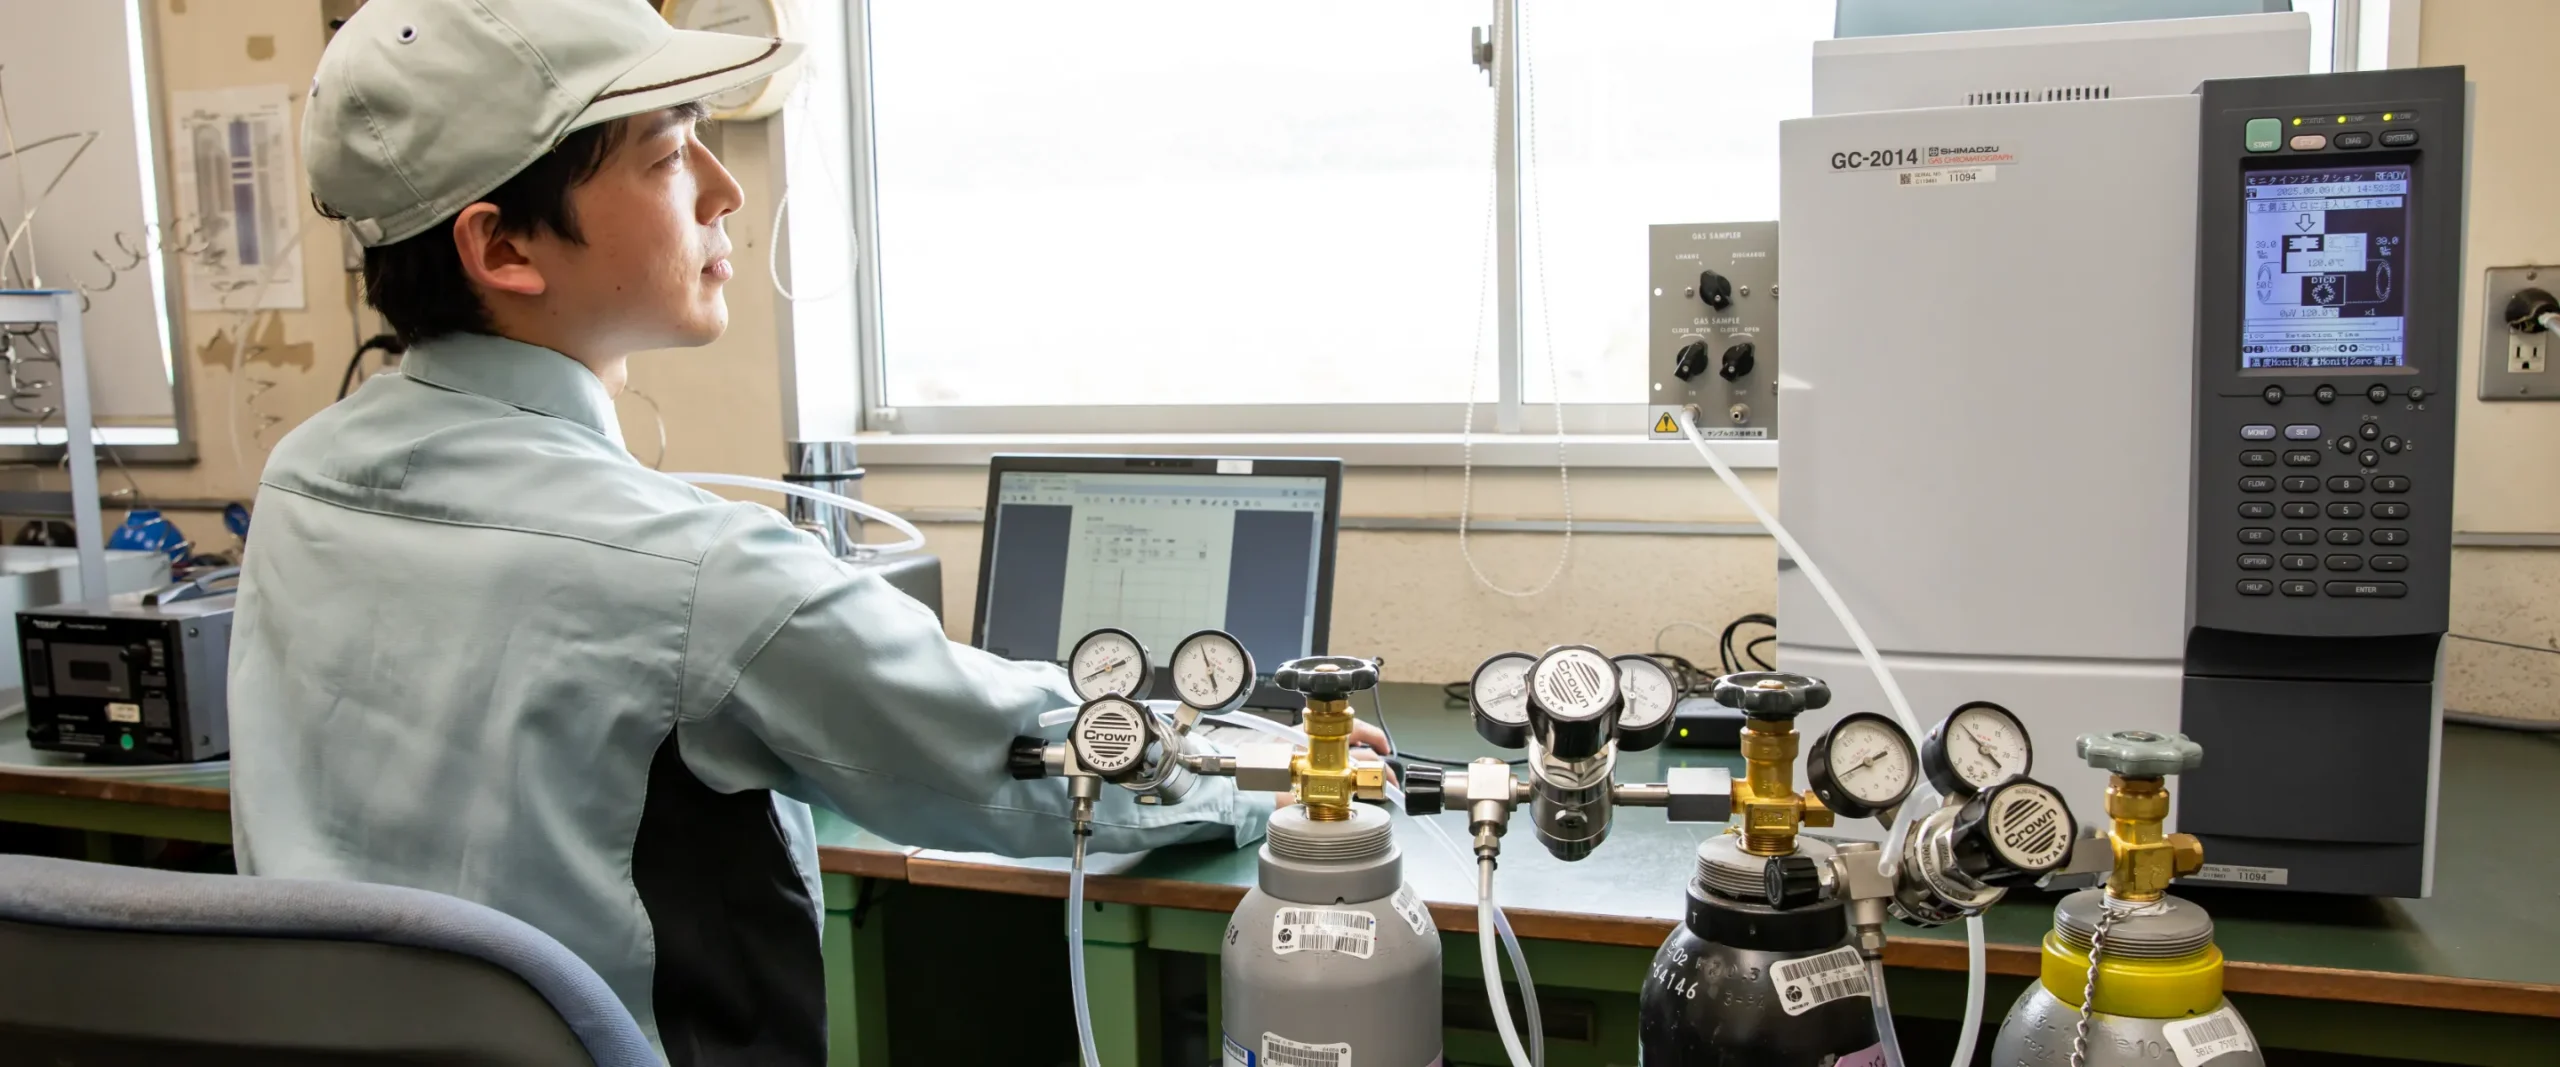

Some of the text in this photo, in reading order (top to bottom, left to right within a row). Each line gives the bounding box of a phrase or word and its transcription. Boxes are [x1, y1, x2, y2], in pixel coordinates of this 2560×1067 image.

[2302, 117, 2325, 125] STATUS
[2345, 137, 2362, 145] DIAG
[2386, 134, 2414, 143] SYSTEM
[2253, 141, 2273, 149] START
[1940, 145, 1999, 155] SHIMADZU
[1831, 148, 1919, 170] GC-2014
[1927, 153, 2014, 165] GAS CHROMATOGRAPH
[1949, 172, 1977, 182] 11094
[2374, 171, 2406, 181] READY
[1691, 231, 1742, 241] GAS SAMPLER
[2311, 276, 2337, 285] DTCD
[1693, 316, 1741, 325] GAS SAMPLE
[2285, 331, 2333, 339] Retention
[2310, 343, 2338, 354] Speed
[2358, 343, 2391, 352] Scroll
[2268, 391, 2281, 399] PF1
[2319, 391, 2333, 399] PF2
[2372, 390, 2385, 398] PF3
[2247, 428, 2268, 437] MONIT
[2251, 454, 2264, 462] COL
[2293, 454, 2311, 462] FUNC
[2248, 480, 2266, 488] FLOW
[2299, 480, 2305, 488] 7
[2343, 480, 2349, 489] 8
[2388, 480, 2395, 489] 9
[2251, 506, 2262, 514] INJ
[2298, 506, 2304, 515] 4
[2343, 506, 2349, 515] 5
[2388, 506, 2394, 515] 6
[2249, 532, 2262, 540] DET
[2342, 532, 2348, 541] 2
[2387, 532, 2393, 541] 3
[2297, 558, 2303, 567] 0
[2295, 585, 2304, 593] CE
[2355, 586, 2377, 594] ENTER
[1556, 659, 1590, 709] Crown
[1538, 674, 1564, 712] YUTAKA
[1083, 729, 1137, 743] Crown
[1087, 752, 1130, 768] YUTAKA
[2003, 808, 2058, 849] Crown
[2026, 833, 2068, 865] YUTAKA
[2239, 872, 2268, 882] 11094
